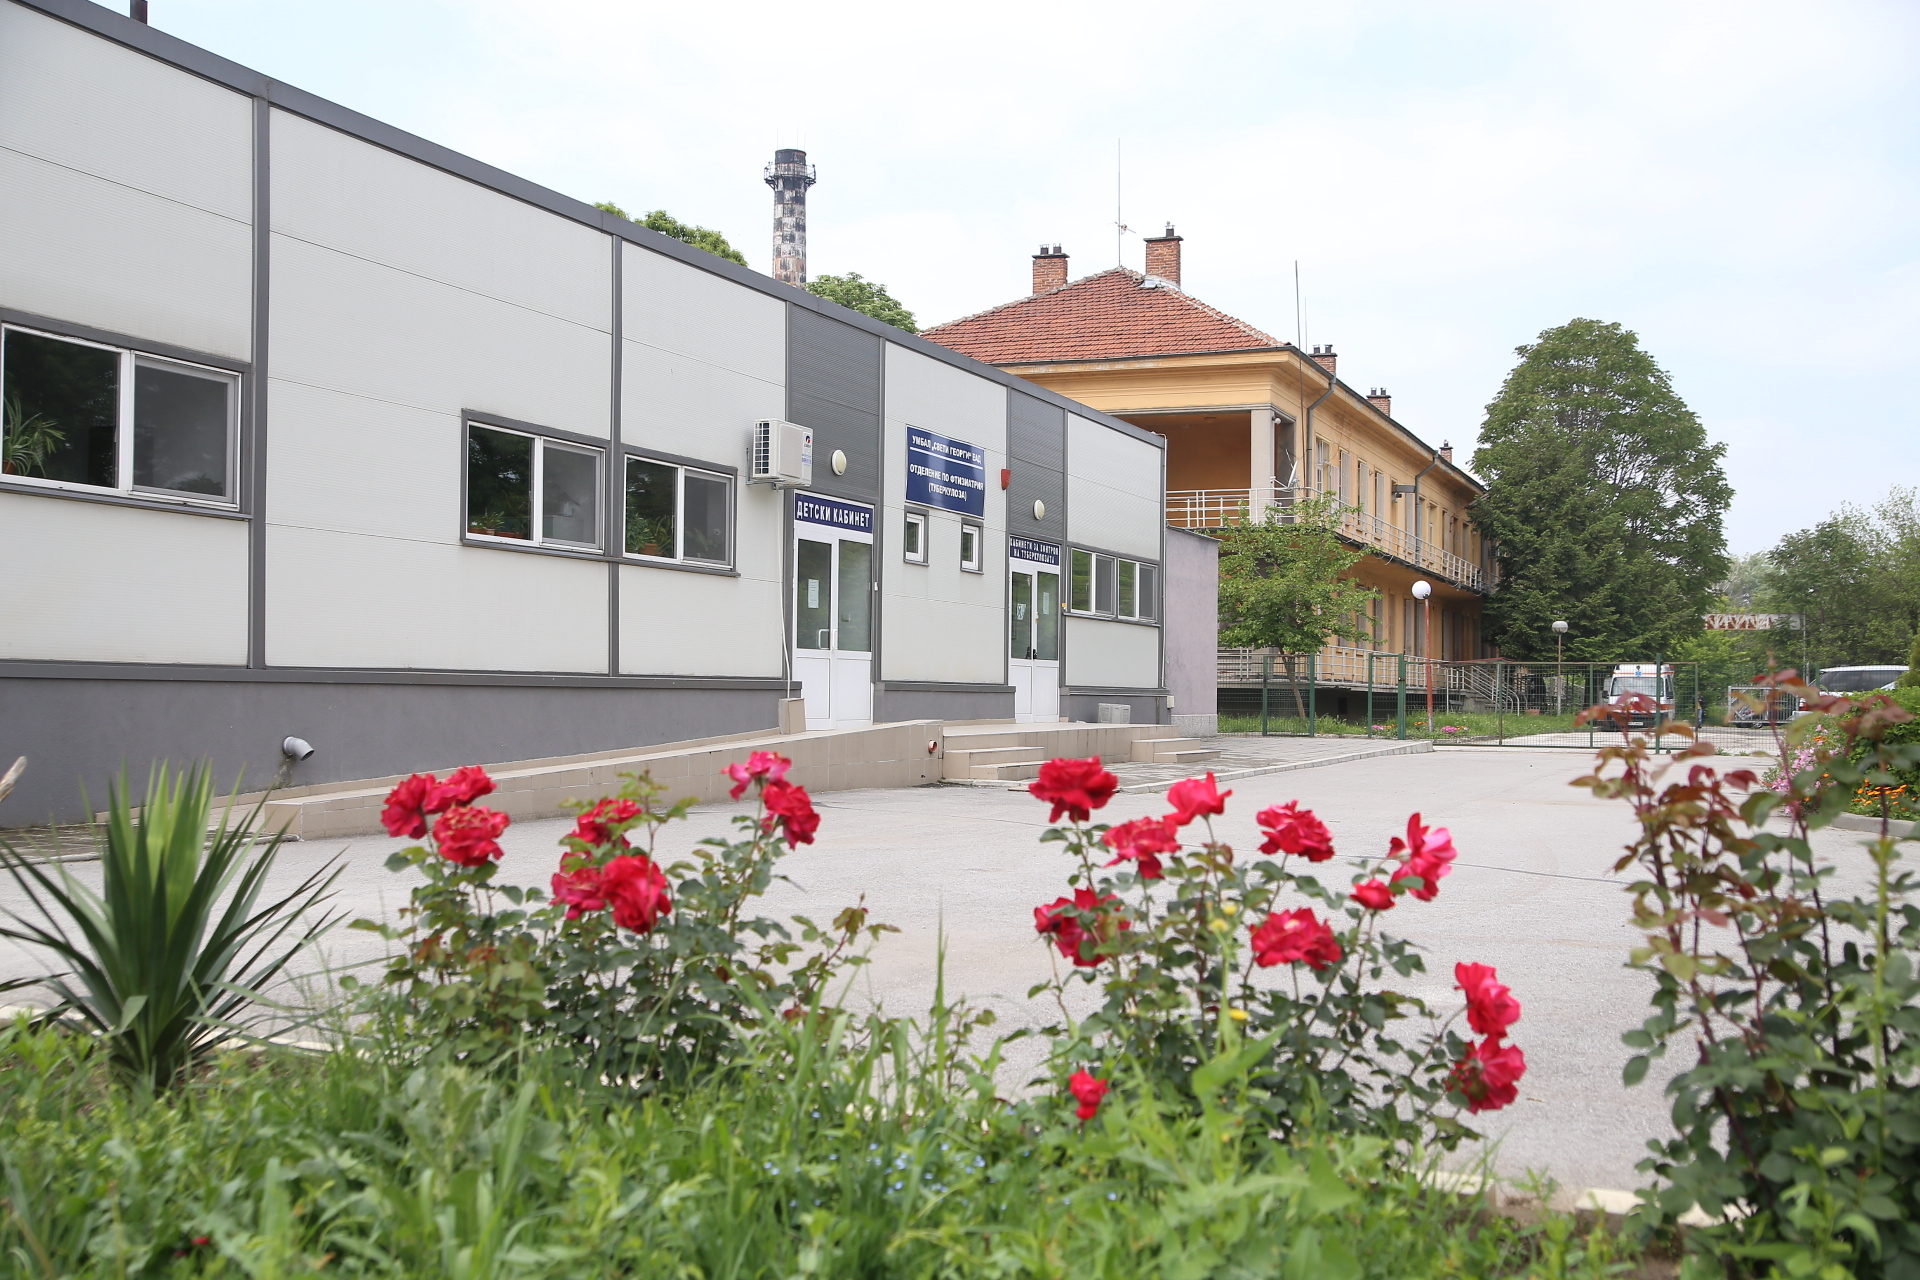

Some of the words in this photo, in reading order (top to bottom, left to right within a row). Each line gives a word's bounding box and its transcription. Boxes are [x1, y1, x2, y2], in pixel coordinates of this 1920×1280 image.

[912, 435, 931, 449] УМБАЛ
[972, 452, 981, 464] ЕАД
[910, 464, 941, 480] ОТДЕЛЕНИЕ
[941, 473, 950, 482] ПО
[950, 475, 983, 491] ФТИЗИАТРИЯ
[928, 482, 967, 501] (ТУБЕРКУЛОЗА)
[797, 501, 831, 521] ДЕТСКИ
[833, 508, 870, 527] КАБИНЕТ
